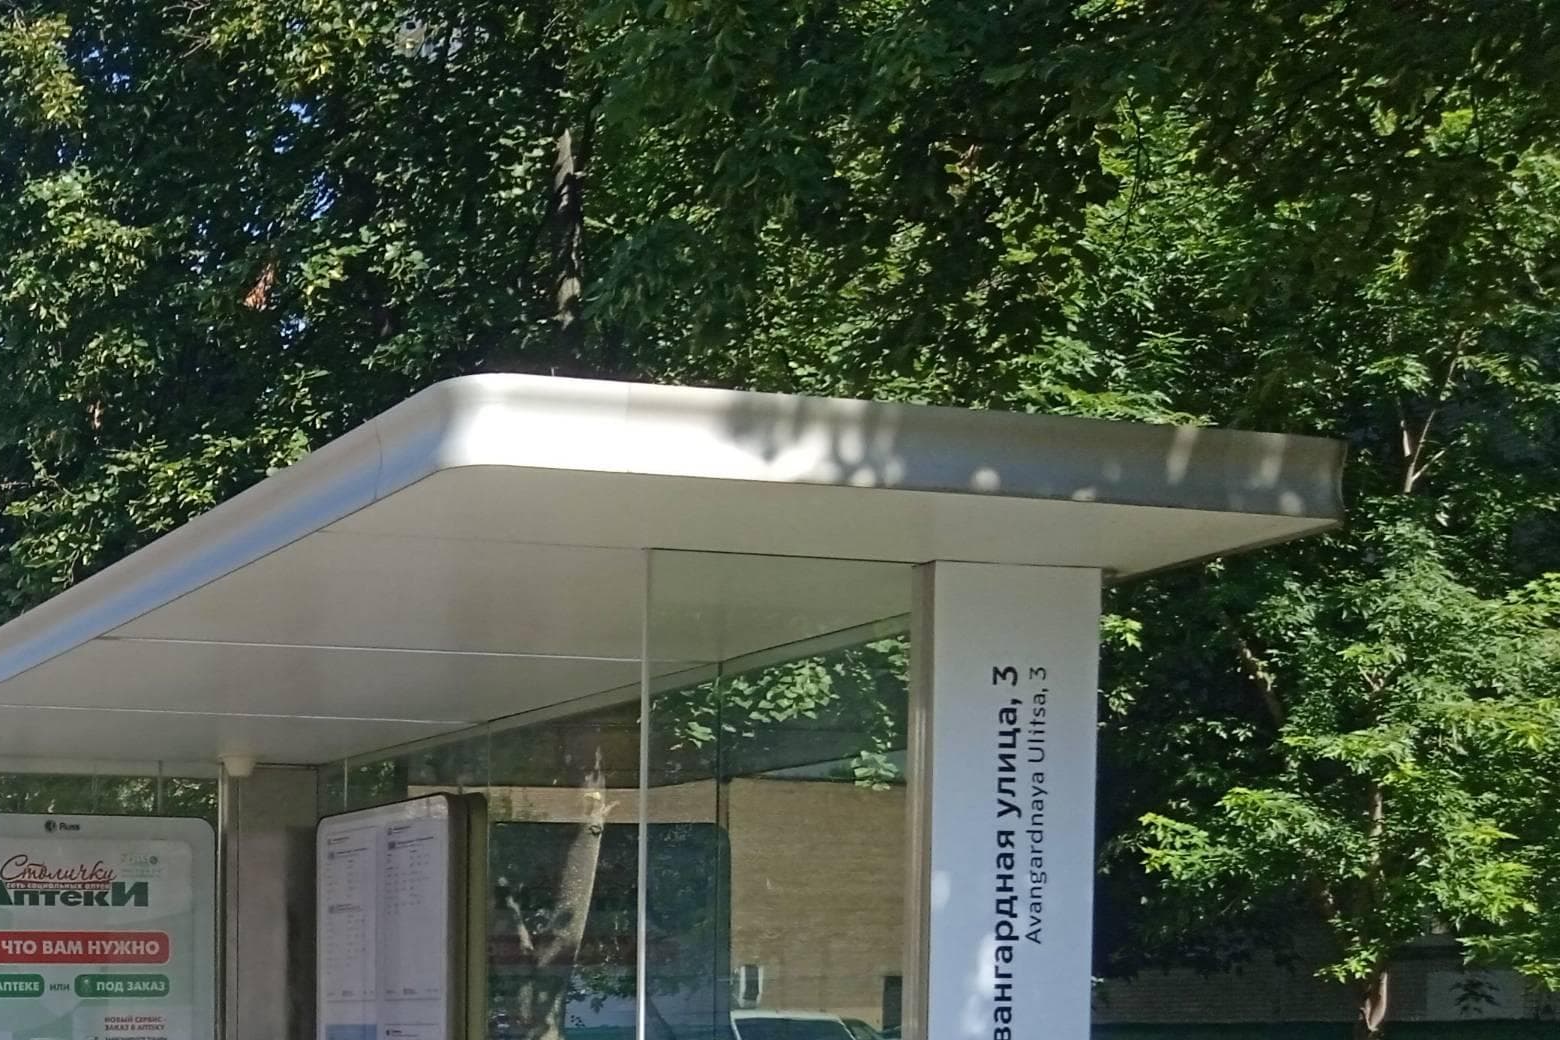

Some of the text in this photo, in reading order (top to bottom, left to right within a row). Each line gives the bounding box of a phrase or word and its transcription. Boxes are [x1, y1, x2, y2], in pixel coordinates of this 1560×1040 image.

[992, 665, 1019, 687] 3
[996, 698, 1024, 819] улица,
[1025, 666, 1049, 944] Avangardnaya Ulitsa, 3
[0, 854, 117, 881] Столички
[1, 940, 37, 955] ЧТО
[42, 940, 83, 955] ВАМ
[87, 940, 160, 955] НУЖНО
[96, 981, 124, 993] ПОД
[127, 981, 165, 992] ЗАКАЗ
